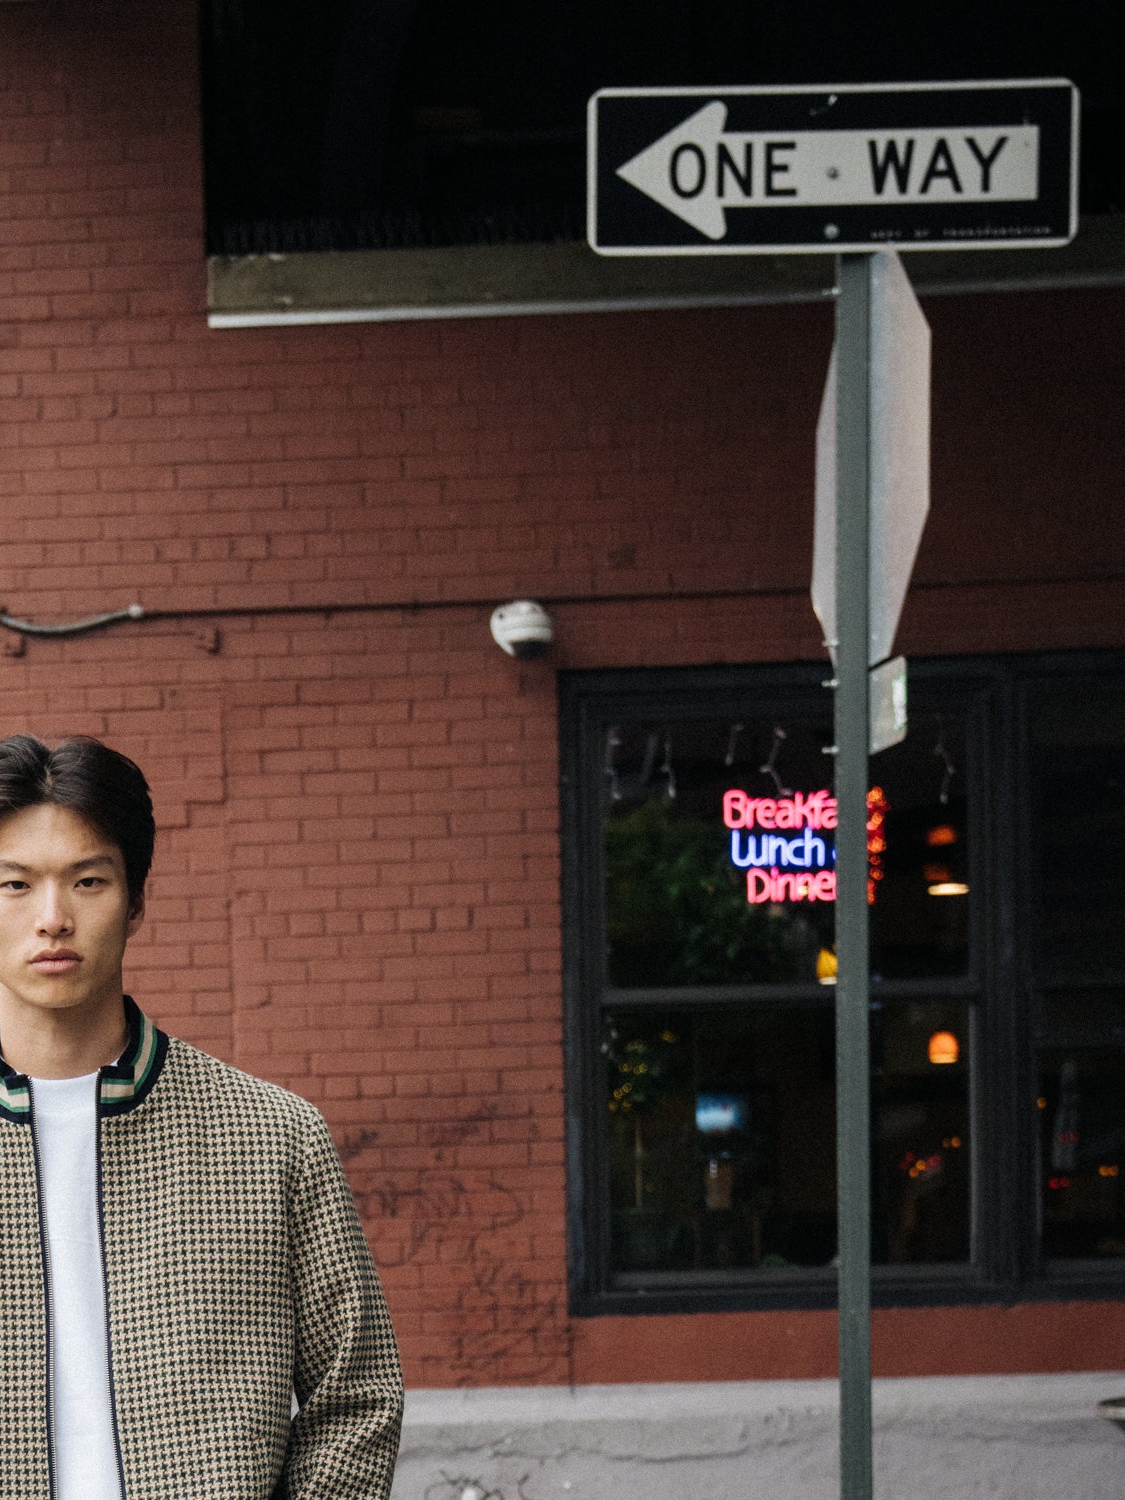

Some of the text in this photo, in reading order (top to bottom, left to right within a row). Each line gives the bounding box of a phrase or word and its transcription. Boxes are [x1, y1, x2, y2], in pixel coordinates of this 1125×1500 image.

[669, 136, 1009, 200] ONE WAY
[723, 788, 876, 830] Breakfa
[731, 827, 826, 868] Lunch
